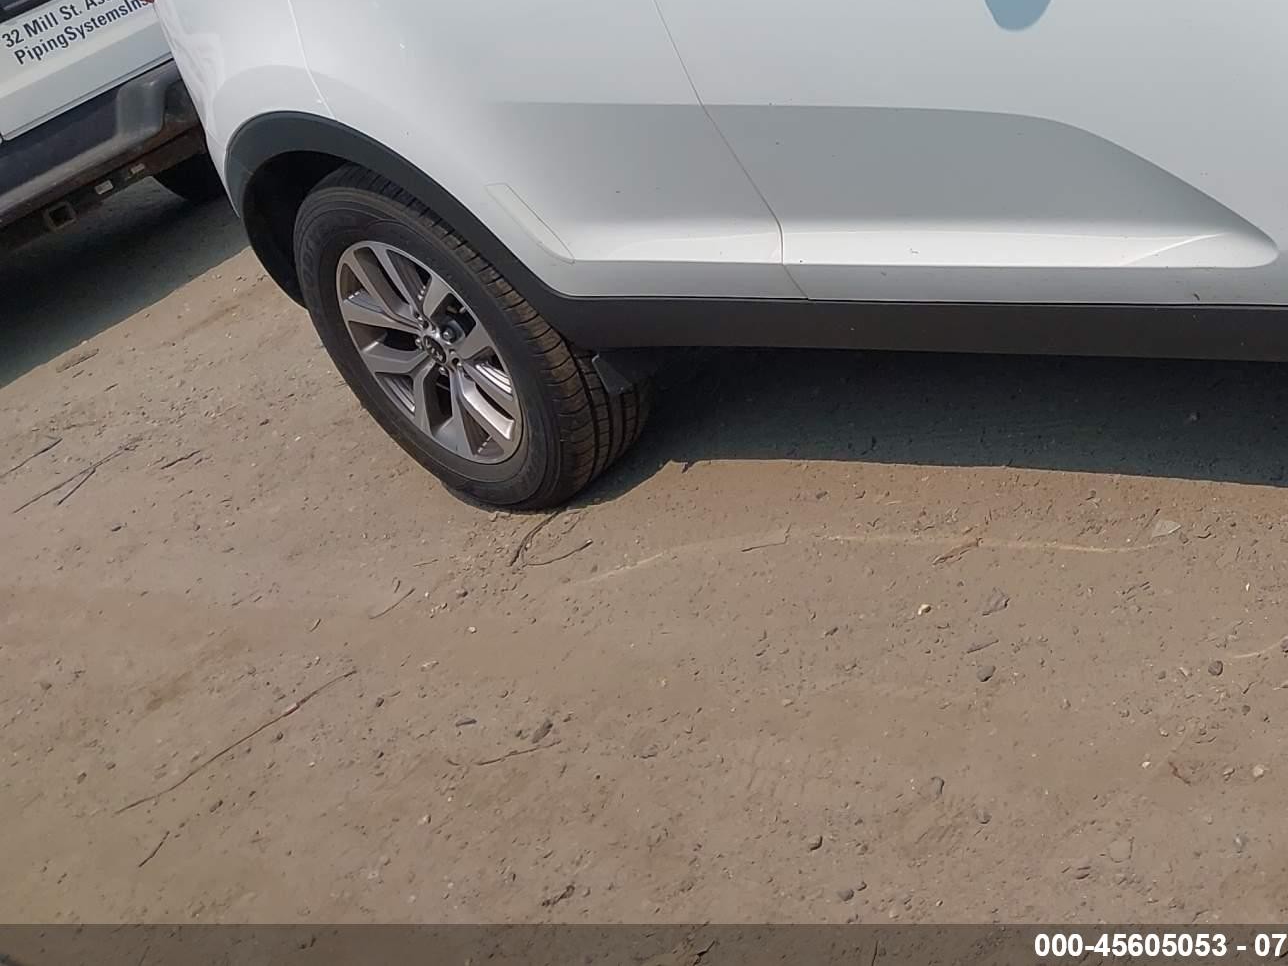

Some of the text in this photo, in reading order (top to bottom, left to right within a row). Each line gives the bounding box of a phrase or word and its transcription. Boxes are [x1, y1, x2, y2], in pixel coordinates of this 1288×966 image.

[2, 29, 24, 48] 32
[23, 12, 59, 38] Mill
[59, 4, 82, 21] St.
